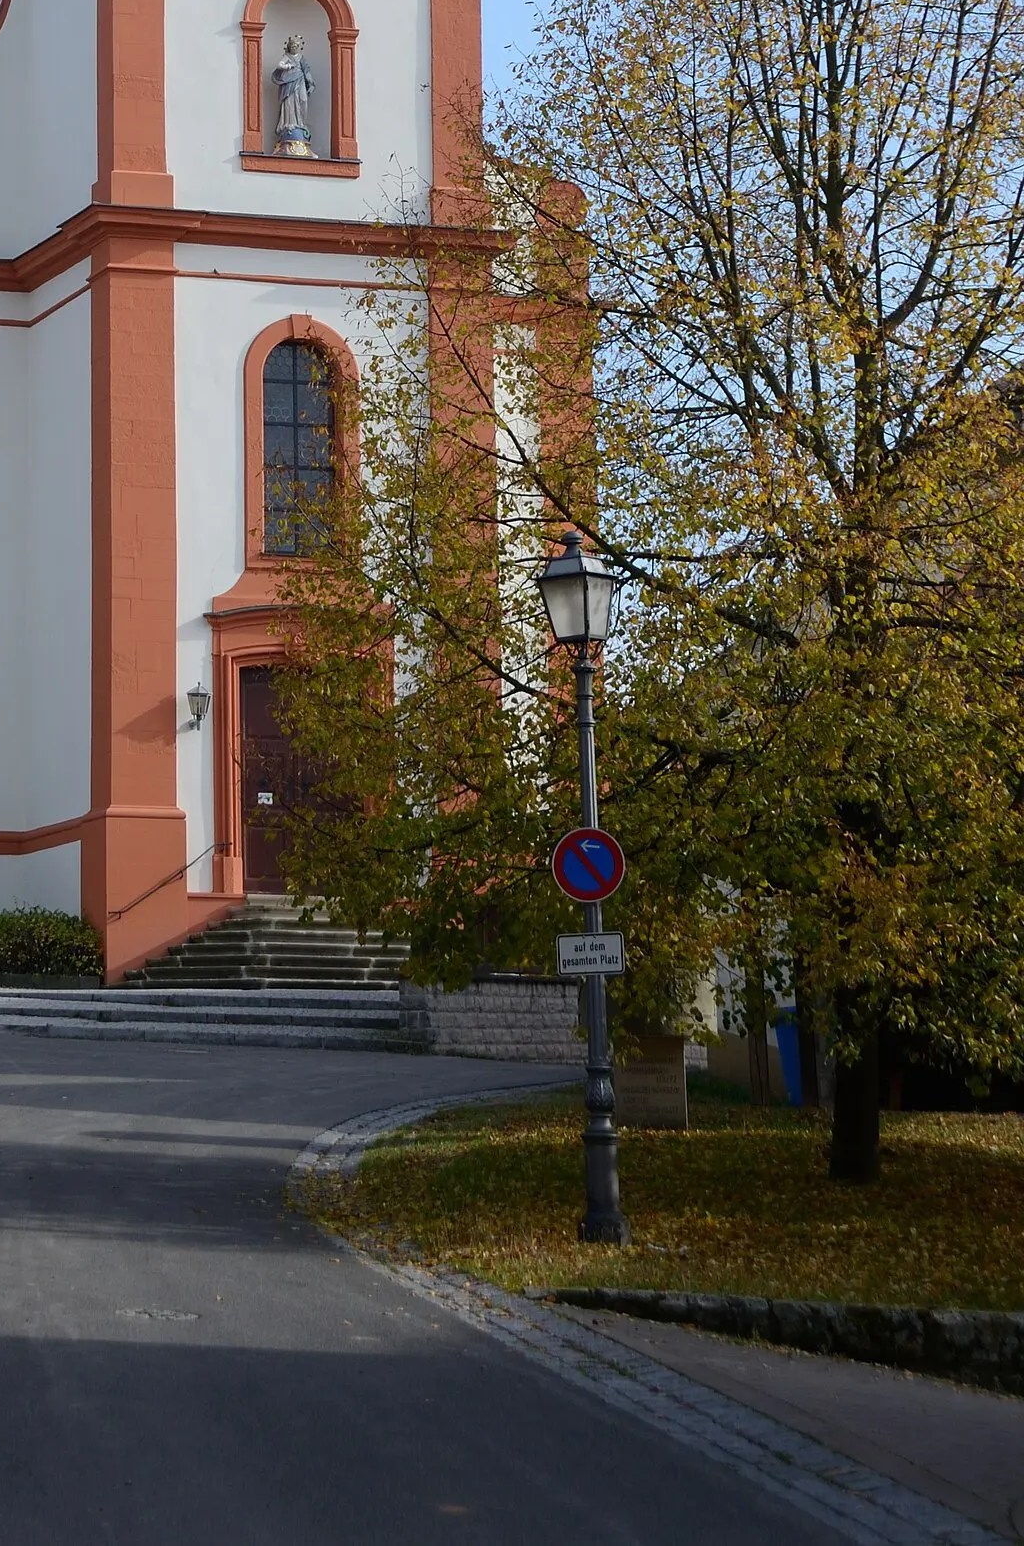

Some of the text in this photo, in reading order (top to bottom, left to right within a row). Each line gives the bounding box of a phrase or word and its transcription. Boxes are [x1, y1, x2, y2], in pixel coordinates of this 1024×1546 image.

[574, 941, 606, 952] auf dem
[562, 953, 619, 969] gesamten Platz
